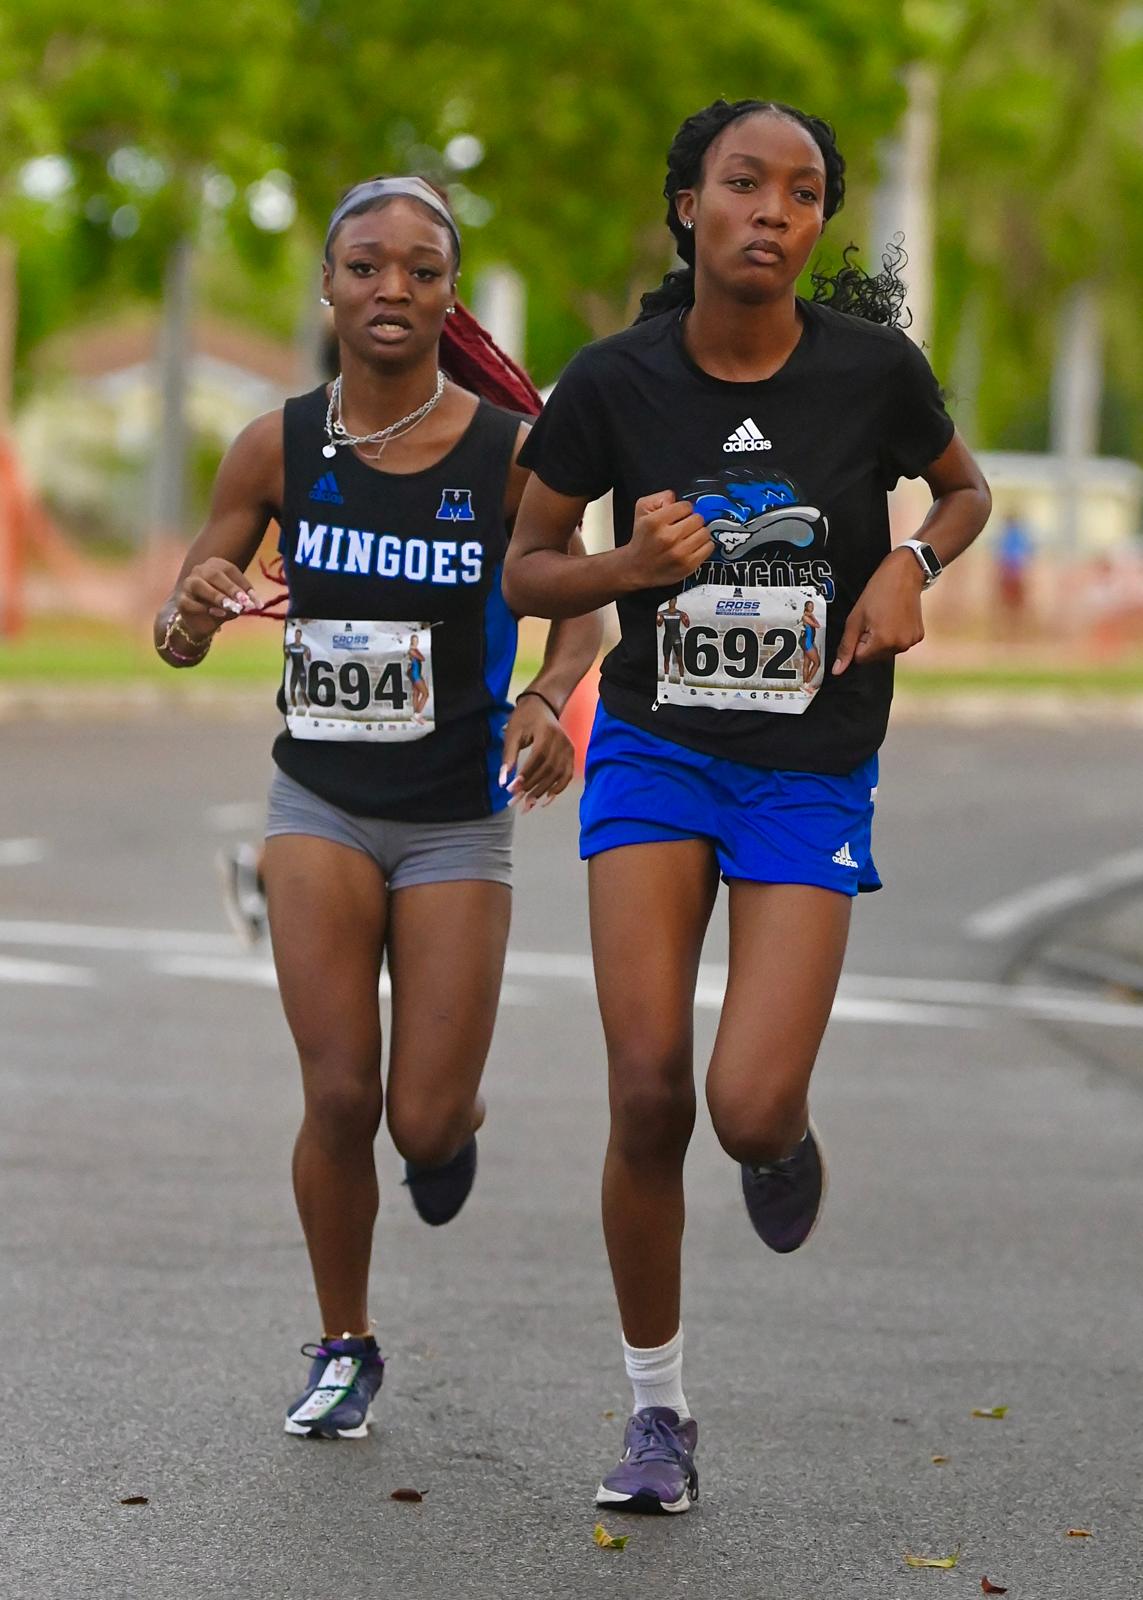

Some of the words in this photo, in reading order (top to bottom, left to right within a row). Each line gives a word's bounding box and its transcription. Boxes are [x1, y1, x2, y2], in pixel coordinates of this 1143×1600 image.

[722, 439, 773, 453] adidas
[293, 519, 483, 585] MINGOES
[716, 600, 761, 609] CROSS
[683, 625, 798, 680] 692
[307, 660, 408, 712] 694
[831, 855, 859, 869] adidas
